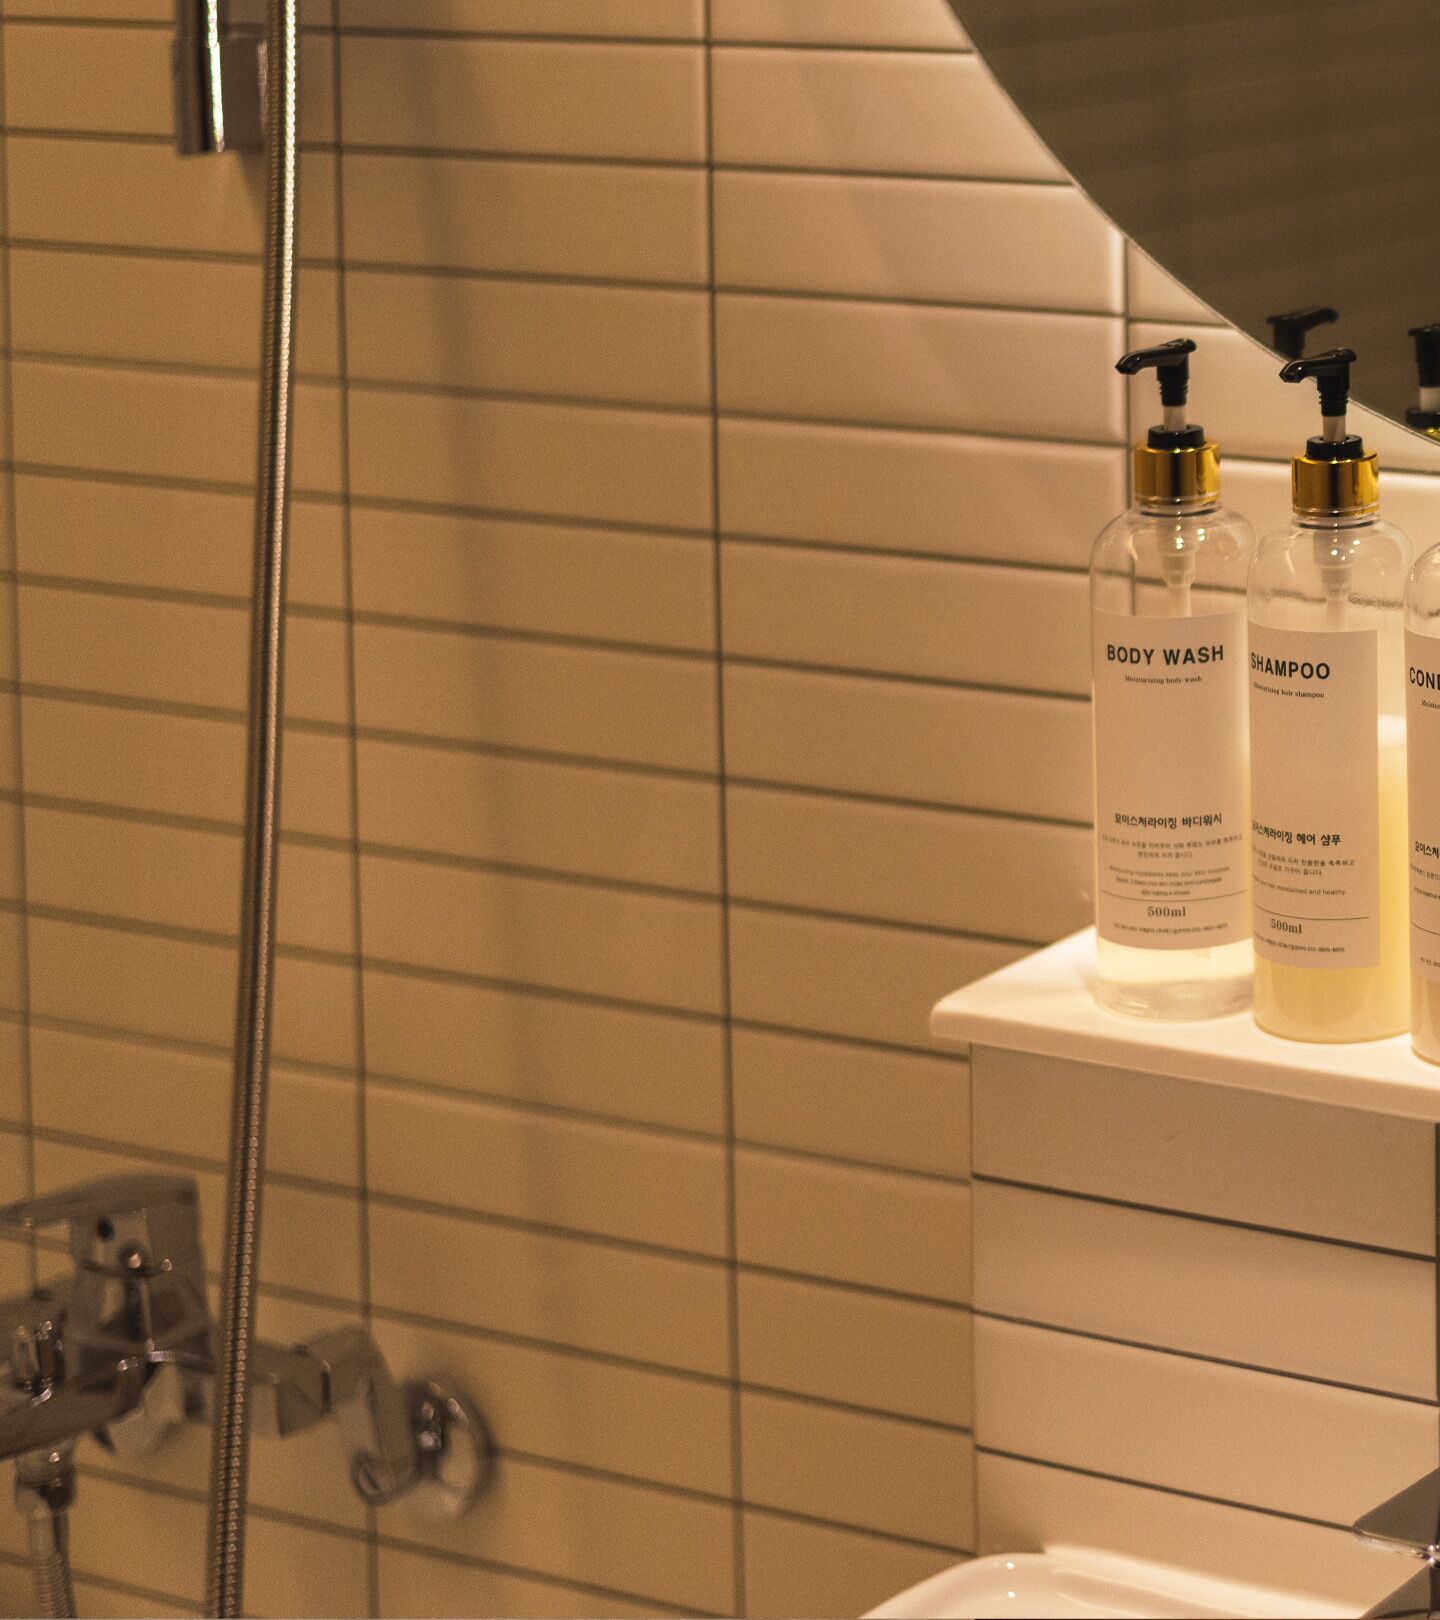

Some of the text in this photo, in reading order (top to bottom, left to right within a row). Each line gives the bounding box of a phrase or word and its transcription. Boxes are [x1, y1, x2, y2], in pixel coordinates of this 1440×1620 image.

[1107, 644, 1224, 665] BODY WASH
[1251, 652, 1331, 680] SHAMPOO
[1166, 676, 1183, 684] body
[1185, 675, 1202, 683] wash
[1295, 690, 1324, 699] shampoo
[1182, 813, 1222, 827] 바디워시
[1297, 833, 1316, 845] 헤어
[1321, 834, 1341, 846] 샴푸
[1147, 906, 1186, 917] 500ml
[1271, 918, 1302, 934] 500ml
